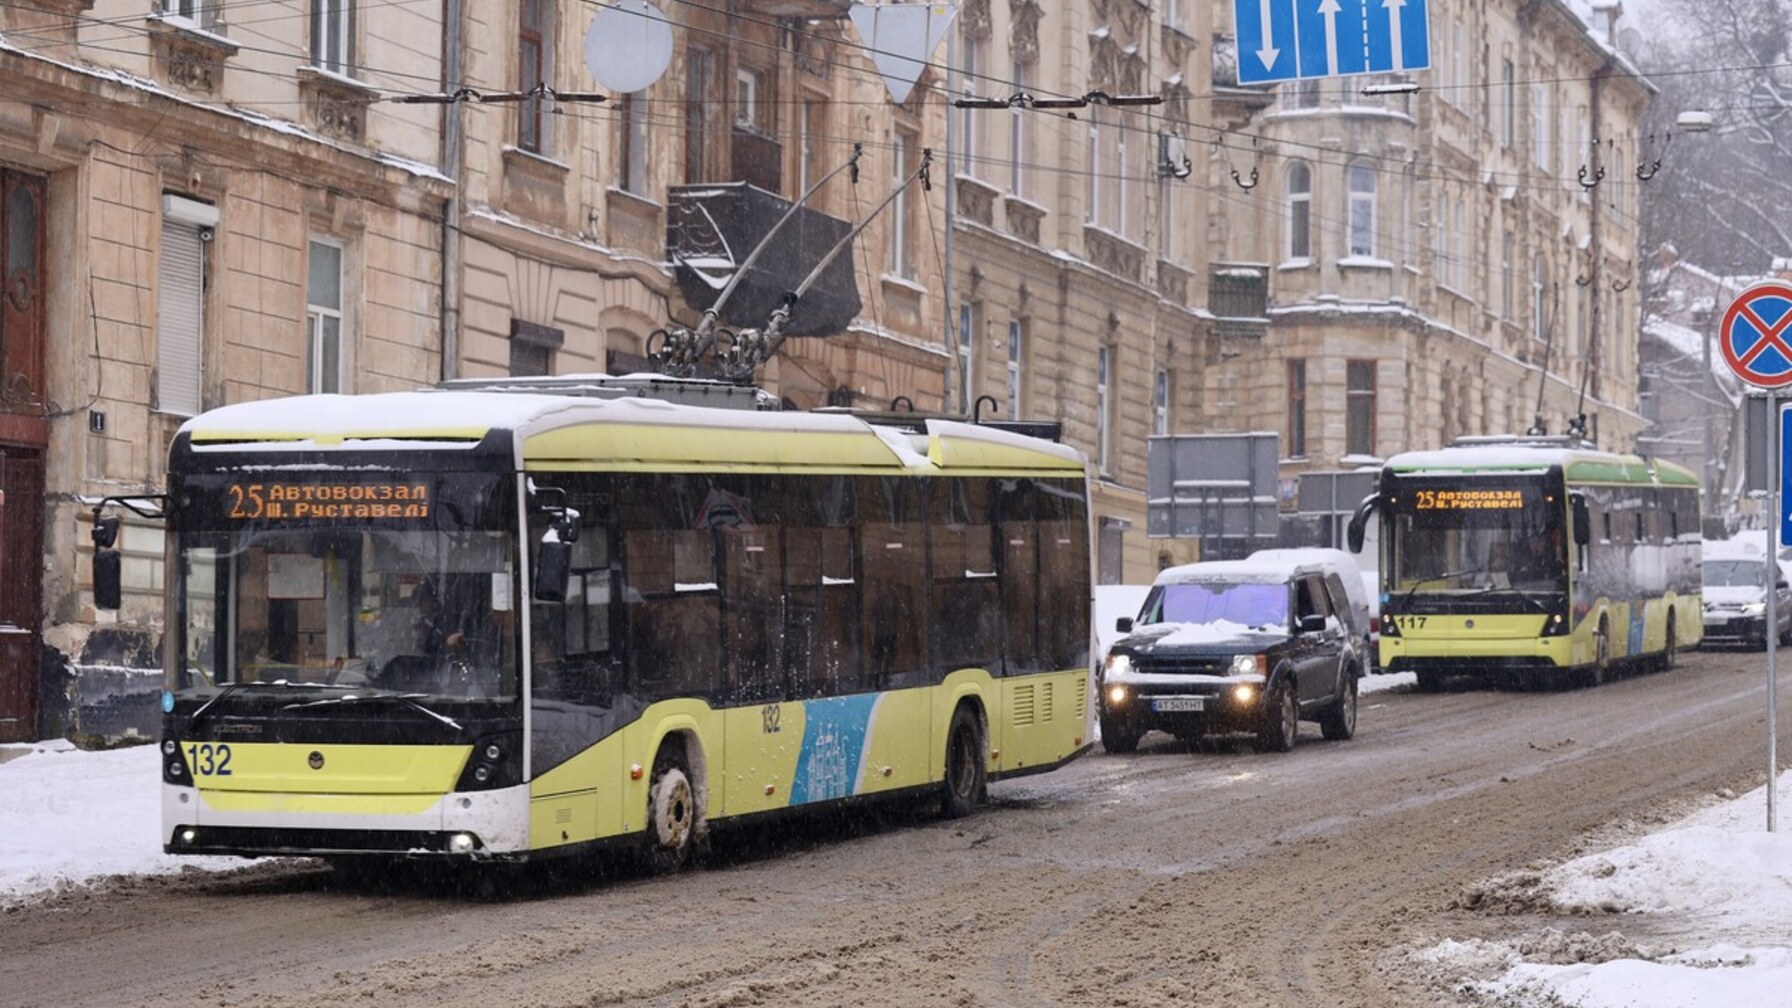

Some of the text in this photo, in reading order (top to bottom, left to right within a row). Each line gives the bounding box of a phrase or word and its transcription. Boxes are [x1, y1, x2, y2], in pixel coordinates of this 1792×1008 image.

[270, 485, 426, 500] Автовокзал
[1416, 491, 1435, 509] 25
[1438, 491, 1521, 500] Автовокзал
[229, 485, 263, 518] 25
[1451, 500, 1522, 509] Руставелі
[267, 502, 428, 518] Ш. Руставелі
[1398, 617, 1427, 629] 117
[762, 704, 780, 734] 132
[188, 744, 232, 776] 132
